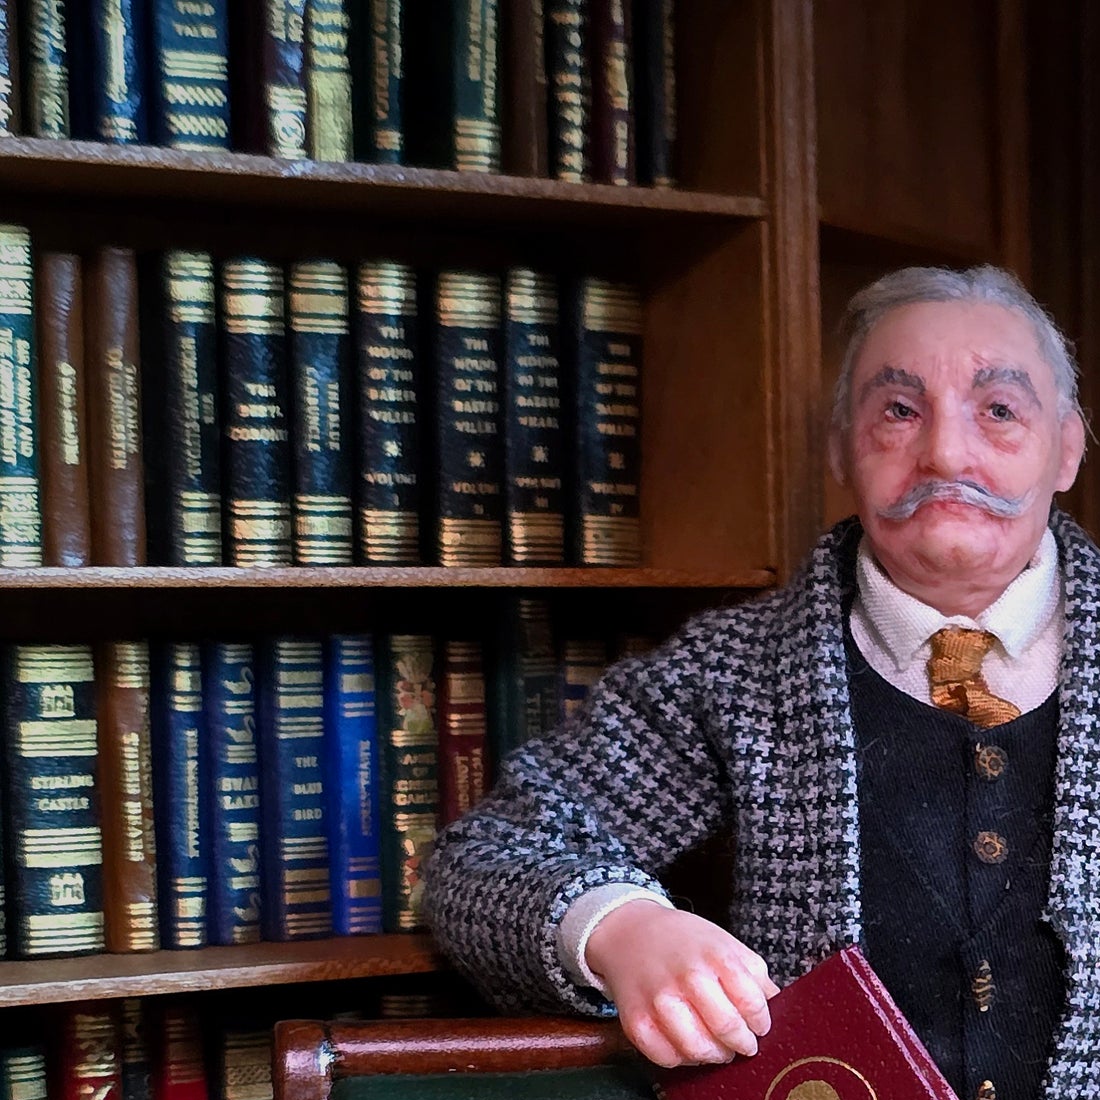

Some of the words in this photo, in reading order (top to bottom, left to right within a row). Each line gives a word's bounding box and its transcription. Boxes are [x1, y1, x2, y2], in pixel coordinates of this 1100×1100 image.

[328, 382, 339, 411] THE
[304, 366, 321, 453] CARBUNCLE
[328, 413, 340, 451] BLUE
[295, 756, 318, 768] THE
[31, 774, 94, 789] STIRLING
[293, 782, 323, 795] BLUE
[38, 797, 90, 811] CASTLE
[222, 795, 260, 810] LAKE
[294, 808, 322, 820] BIRD
